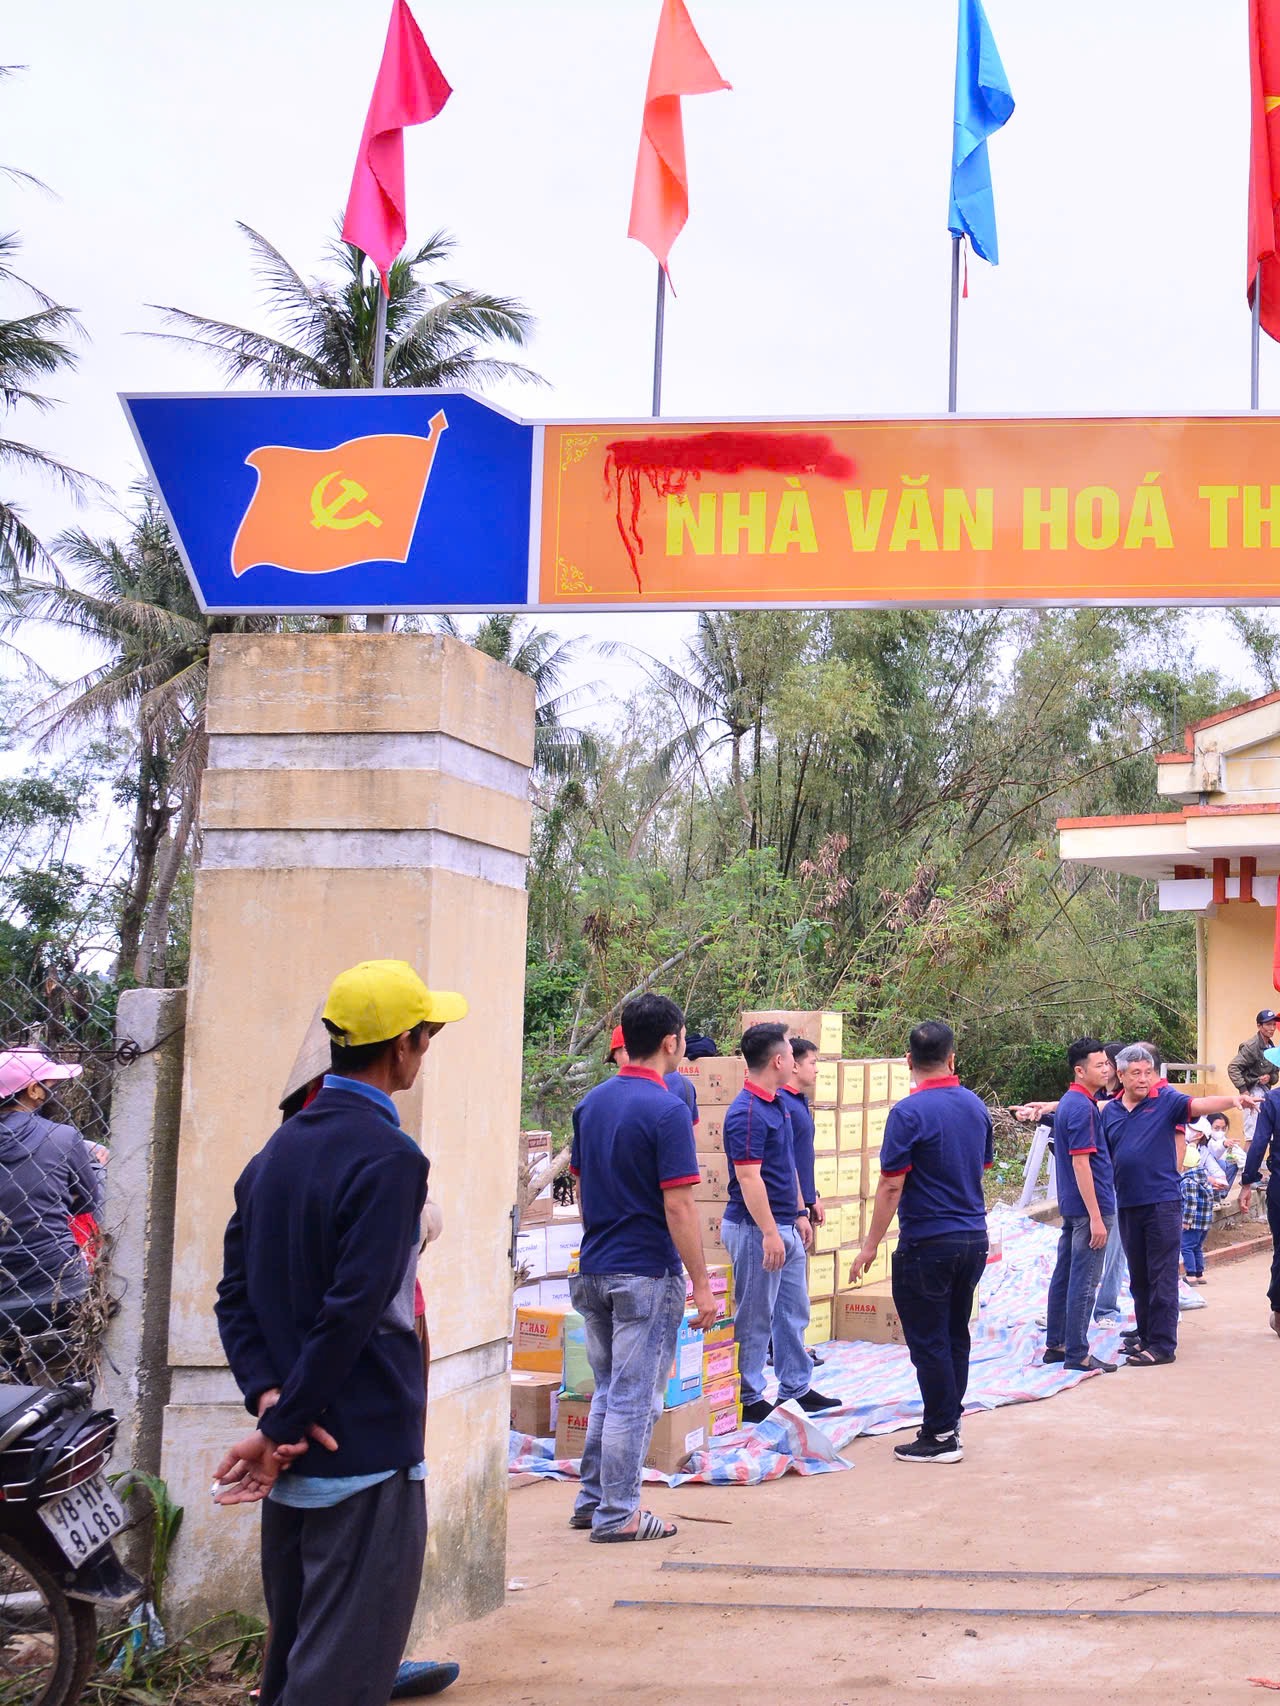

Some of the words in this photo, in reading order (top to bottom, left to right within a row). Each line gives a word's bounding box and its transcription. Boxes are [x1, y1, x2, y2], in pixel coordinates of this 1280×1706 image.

[666, 478, 818, 556] NHÀ
[844, 474, 994, 552] VĂN
[1023, 471, 1174, 550] HOÁ
[845, 1303, 877, 1313] FAHASA
